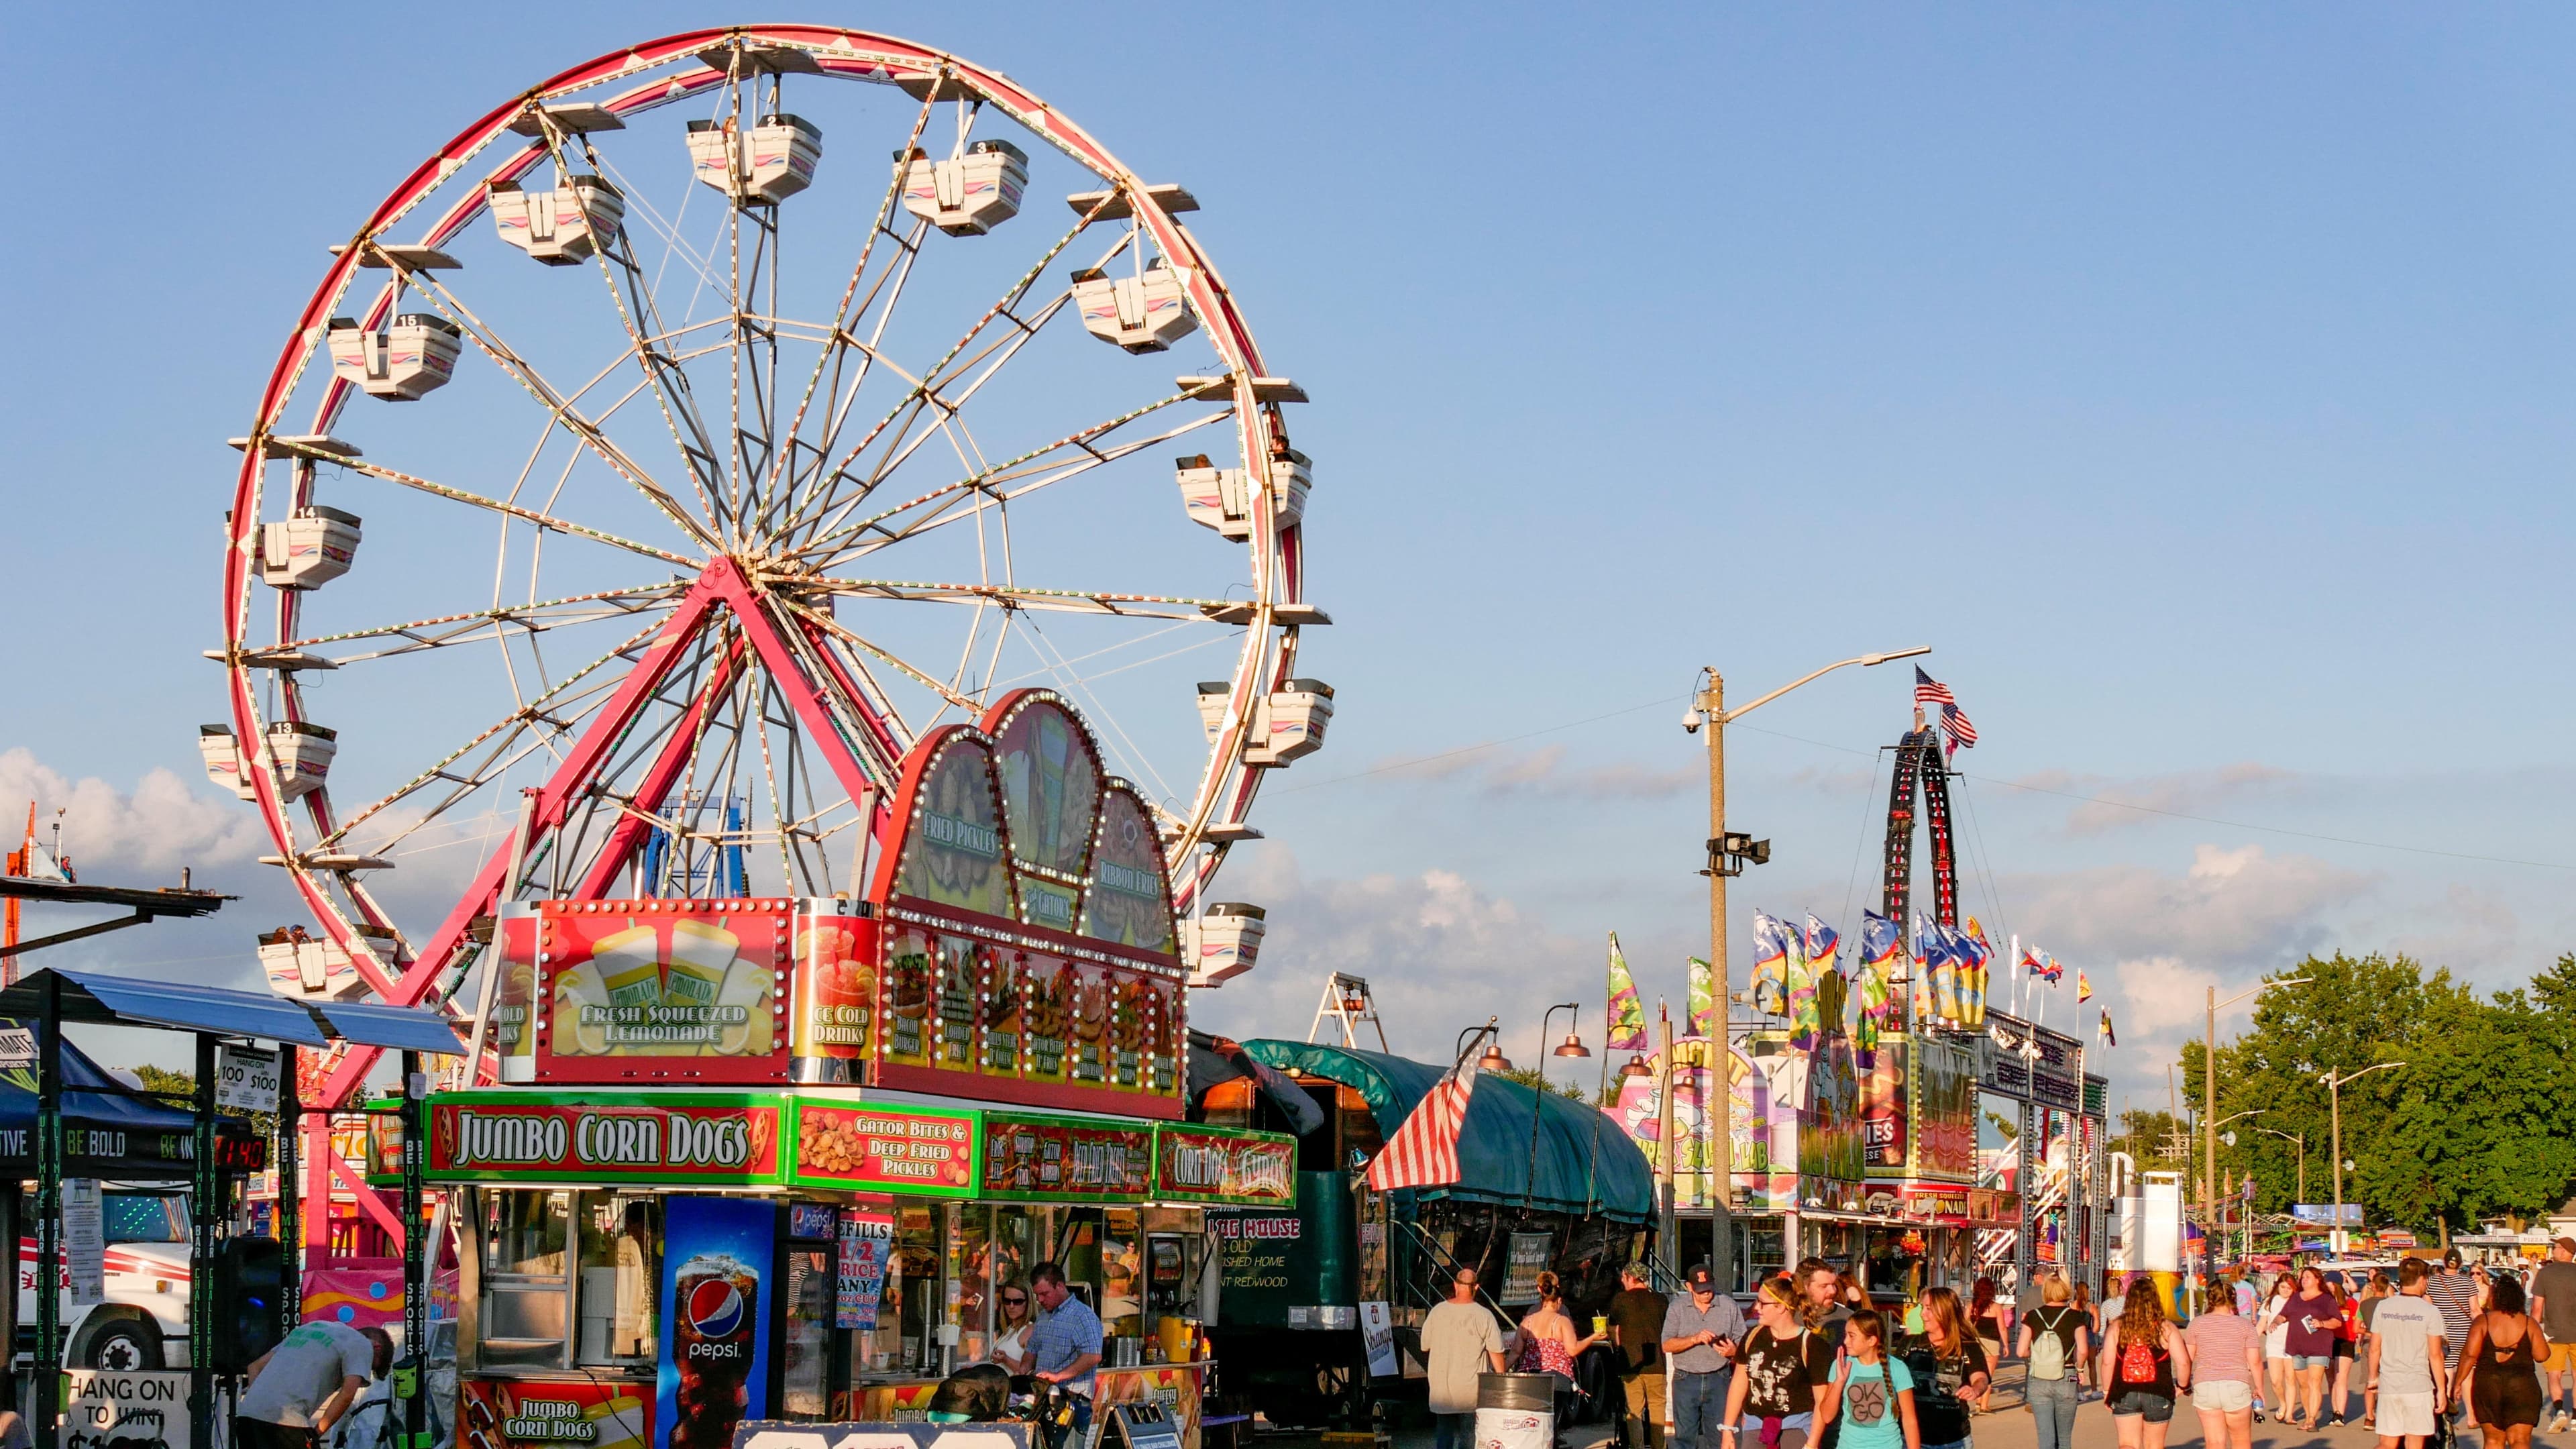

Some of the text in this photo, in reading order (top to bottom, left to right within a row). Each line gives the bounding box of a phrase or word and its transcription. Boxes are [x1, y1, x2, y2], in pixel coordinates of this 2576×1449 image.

[767, 116, 776, 127] 2
[977, 142, 986, 153] 3
[400, 315, 417, 327] 15
[299, 507, 315, 519] 14
[1285, 681, 1295, 693] 6
[276, 722, 292, 734] 13
[924, 812, 996, 854] FRIED PICKLES
[1101, 861, 1158, 896] RIBBON FRIES
[1216, 904, 1226, 916] 7
[581, 1006, 746, 1022] FRESH SQUEEZED
[814, 1006, 868, 1024] CE COLD
[605, 1025, 720, 1042] LEMONADE
[814, 1025, 865, 1042] DRINKS
[897, 1016, 918, 1034] BACON
[945, 1023, 970, 1041] LOADED
[894, 1034, 920, 1053] BURGER
[949, 1042, 966, 1058] FRIES
[237, 1058, 265, 1069] HANG ON
[222, 1065, 244, 1082] 100
[250, 1075, 277, 1091] $100
[855, 1118, 965, 1140] GATOR BITES &
[1865, 1121, 1894, 1144] IES
[68, 1130, 125, 1157] BE BOLD
[161, 1135, 176, 1159] BE
[457, 1113, 566, 1165] JUMBO
[577, 1115, 659, 1163] CORN
[669, 1116, 749, 1165] DOGS
[991, 1138, 1004, 1158] FROG
[869, 1139, 951, 1160] DEEP FRIED
[1044, 1142, 1061, 1161] GATOR
[1739, 1141, 1768, 1171] LAB
[1865, 1150, 1880, 1161] ESE
[882, 1159, 937, 1177] PICKLES
[991, 1161, 1003, 1181] LEGS
[1074, 1140, 1087, 1183] DEEP
[1089, 1140, 1104, 1184] FRIED
[1106, 1142, 1126, 1186] TREATS
[1175, 1143, 1201, 1184] CORN
[1203, 1146, 1228, 1186] DOGS
[806, 1212, 830, 1232] pepsi
[839, 1221, 888, 1240] EFILLS
[1243, 1218, 1301, 1238] HOUSE
[839, 1240, 875, 1263] 1/2
[1230, 1240, 1252, 1253] OLD
[1223, 1256, 1286, 1267] ISHED HOME
[840, 1263, 879, 1279] RICE
[837, 1279, 871, 1293] ANY
[1234, 1277, 1288, 1287] REDWOOD
[855, 1295, 877, 1305] CUP
[281, 1287, 289, 1338] SPOR
[406, 1282, 414, 1356] SPORTS
[1364, 1325, 1392, 1354] Strange
[689, 1342, 739, 1360] pepsi
[70, 1377, 174, 1401] HANG ON
[1152, 1388, 1177, 1405] CHEESY
[1847, 1382, 1882, 1403] OK
[85, 1405, 109, 1424] TO
[521, 1400, 578, 1419] JUMBO
[895, 1409, 927, 1422] JUMBO
[1851, 1400, 1884, 1422] GO
[505, 1419, 594, 1438] CORN DOGS
